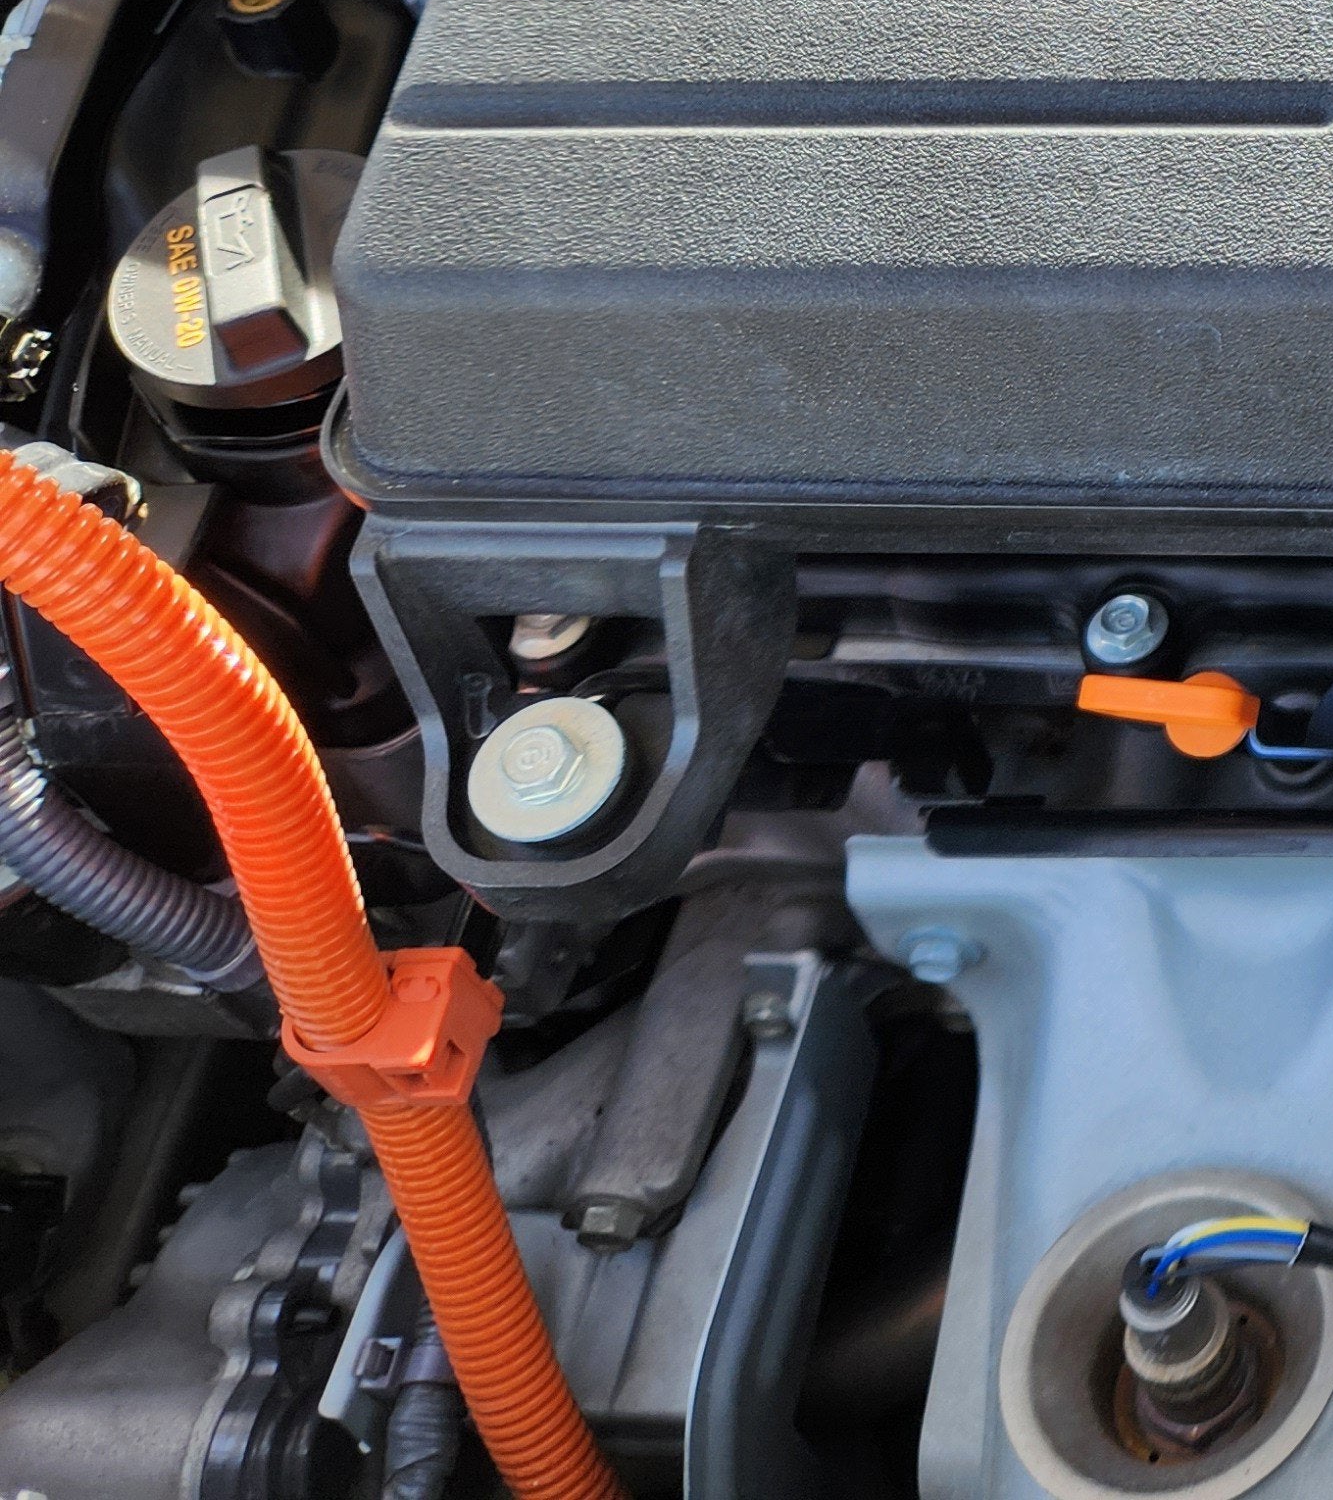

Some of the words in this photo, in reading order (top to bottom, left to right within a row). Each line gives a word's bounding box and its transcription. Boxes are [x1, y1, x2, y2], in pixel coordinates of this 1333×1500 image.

[166, 224, 199, 275] SAE
[117, 262, 140, 326] OWNER'S
[171, 276, 207, 349] 0W-20
[126, 328, 174, 372] MANUAL
